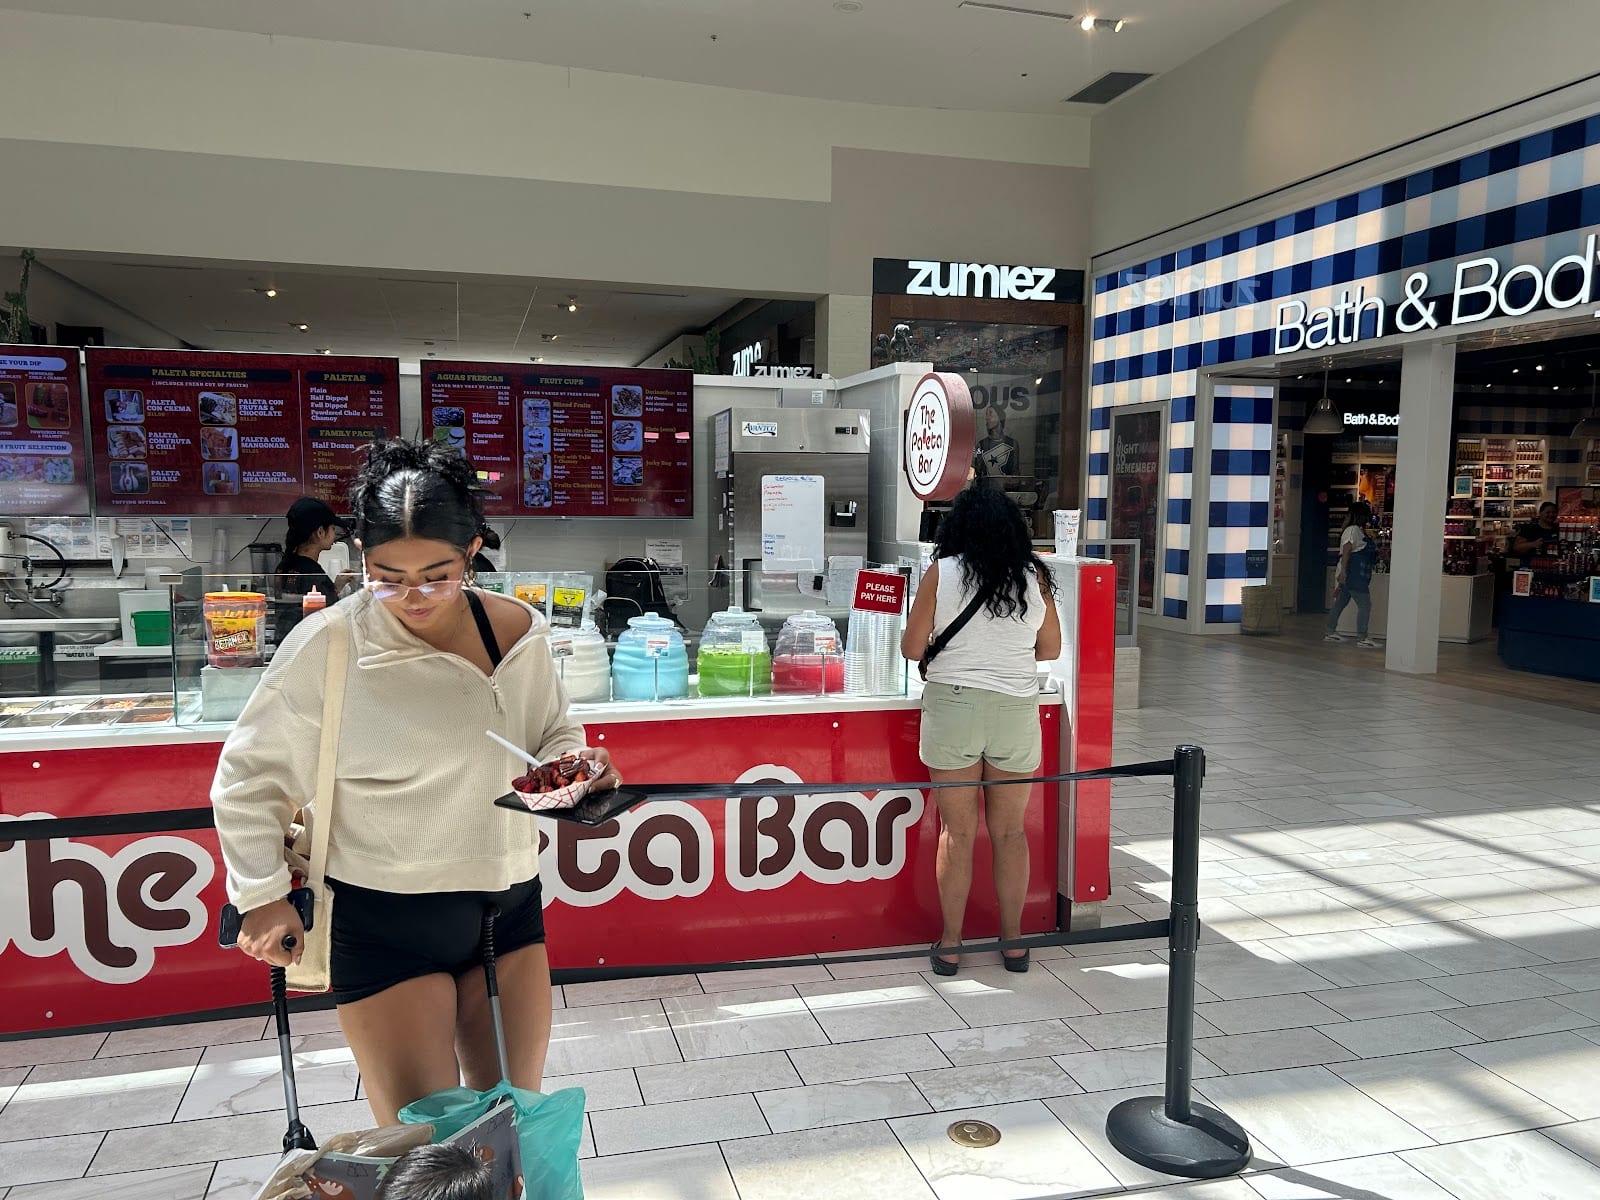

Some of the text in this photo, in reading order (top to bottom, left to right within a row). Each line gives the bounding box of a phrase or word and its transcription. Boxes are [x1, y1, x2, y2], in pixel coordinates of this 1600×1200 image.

[906, 260, 1056, 301] zumiez
[1274, 233, 1600, 356] Bath & Bod
[151, 368, 247, 379] PALETA SPECIALTIES
[323, 374, 366, 382] PALETAS
[437, 373, 504, 382] AGUAS FRESCAS
[539, 377, 563, 385] FRUIT
[238, 398, 267, 406] PALETA
[324, 402, 348, 410] Dipped
[472, 412, 503, 420] Blueberry
[920, 405, 936, 430] The
[1343, 412, 1400, 426] Bath & Bod
[320, 430, 375, 438] FAMILY PACK
[911, 428, 943, 452] Paleta
[918, 453, 933, 474] Bar
[1115, 462, 1157, 474] REMEMBER
[313, 472, 338, 480] Dozen
[866, 582, 896, 594] PLEASE
[860, 592, 898, 604] PAY HERE
[0, 837, 198, 968] he
[739, 777, 912, 878] Bar
